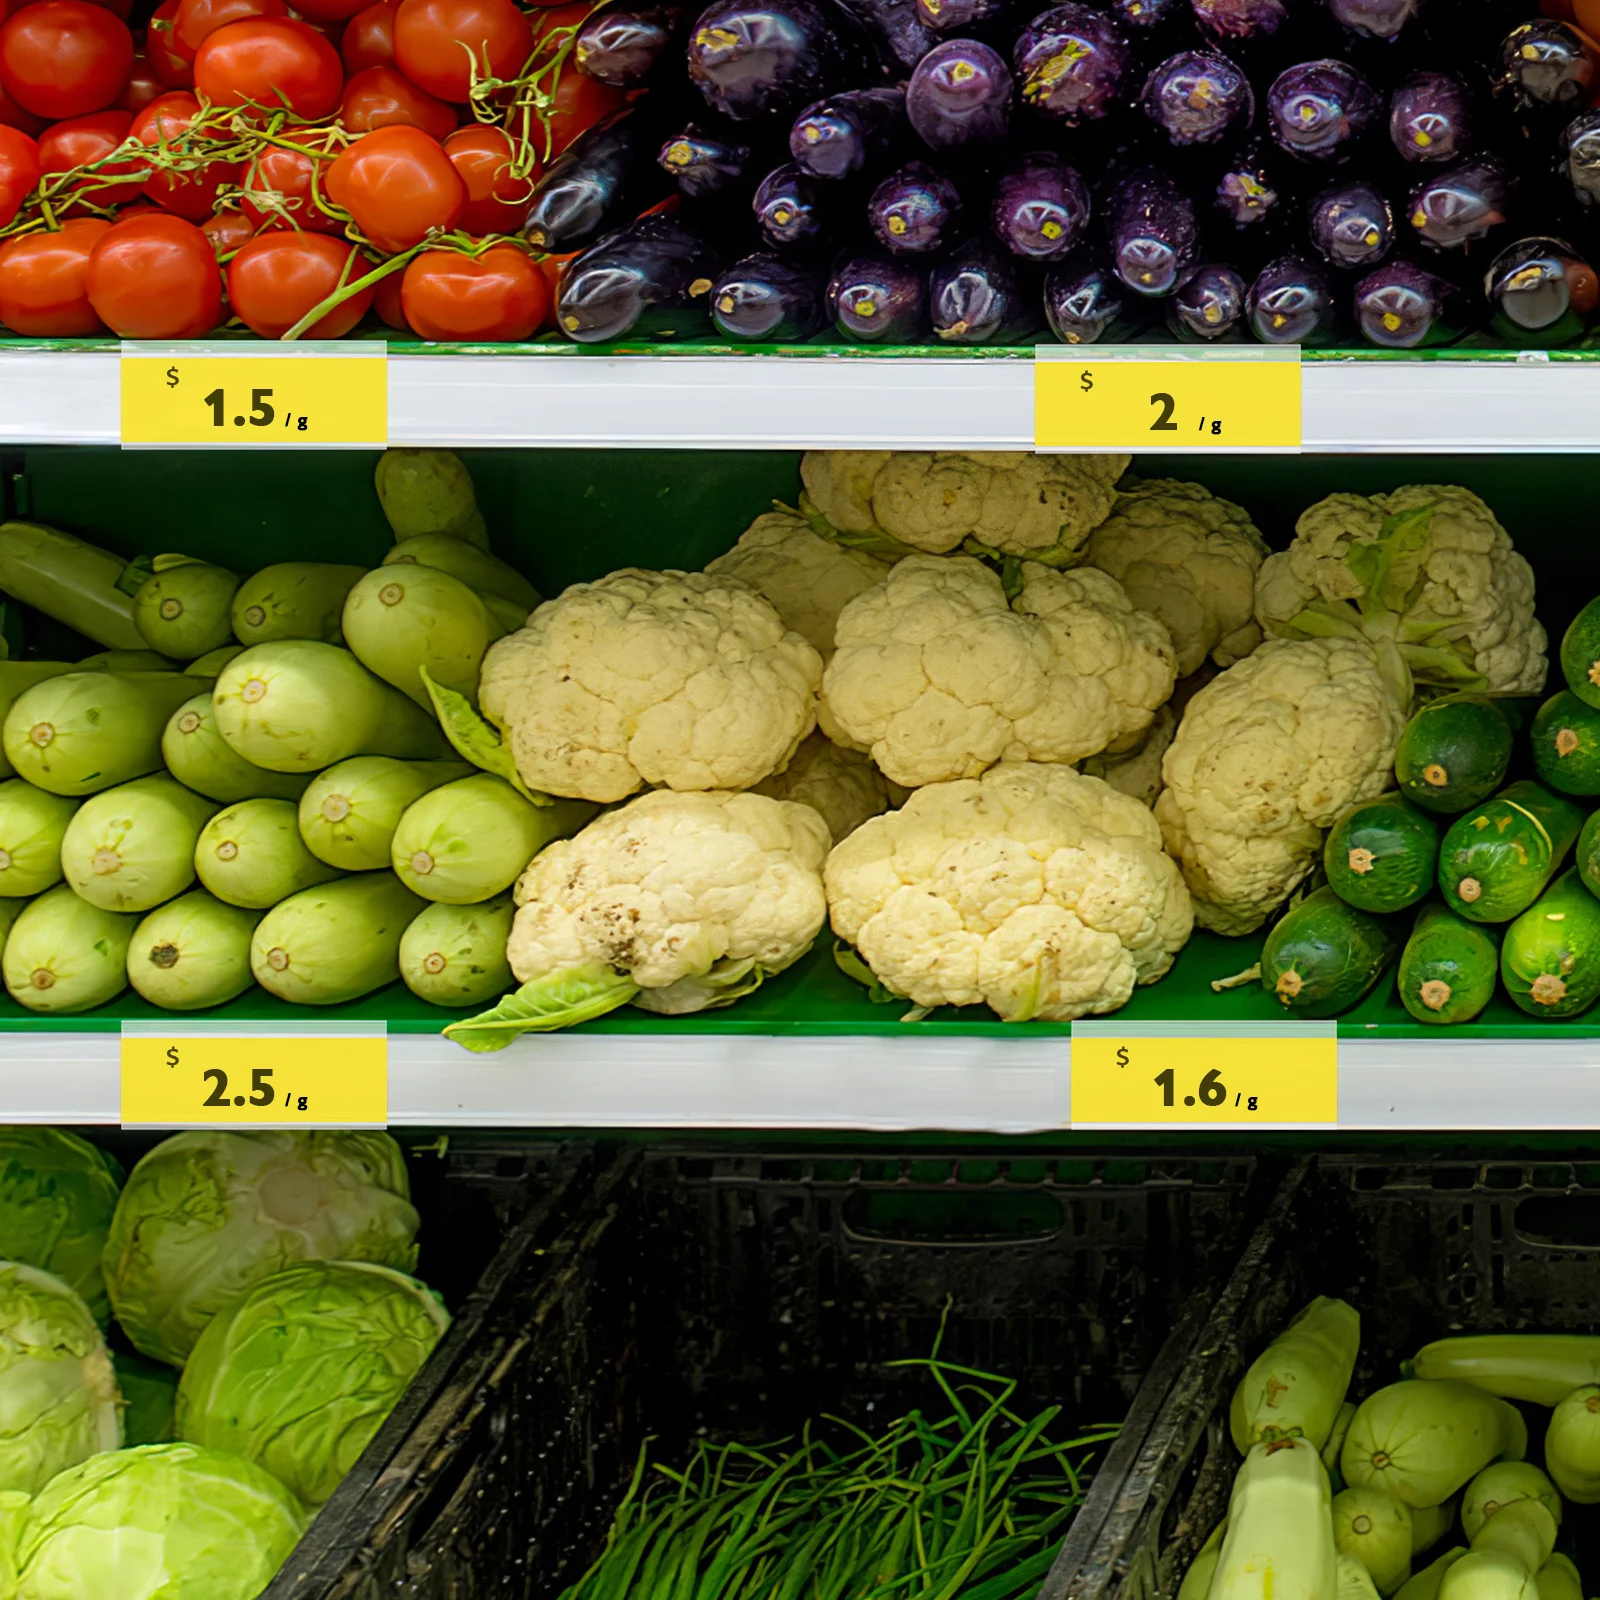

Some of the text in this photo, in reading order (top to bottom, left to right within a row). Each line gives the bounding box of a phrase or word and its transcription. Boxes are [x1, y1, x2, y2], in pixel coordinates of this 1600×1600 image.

[166, 366, 180, 389] $
[203, 388, 275, 427] 1.5
[1080, 370, 1094, 393] $
[1149, 392, 1178, 431] 2
[166, 1046, 180, 1069] $
[202, 1068, 275, 1107] 2.5
[1116, 1046, 1130, 1069] $
[1153, 1068, 1227, 1107] 1.6
